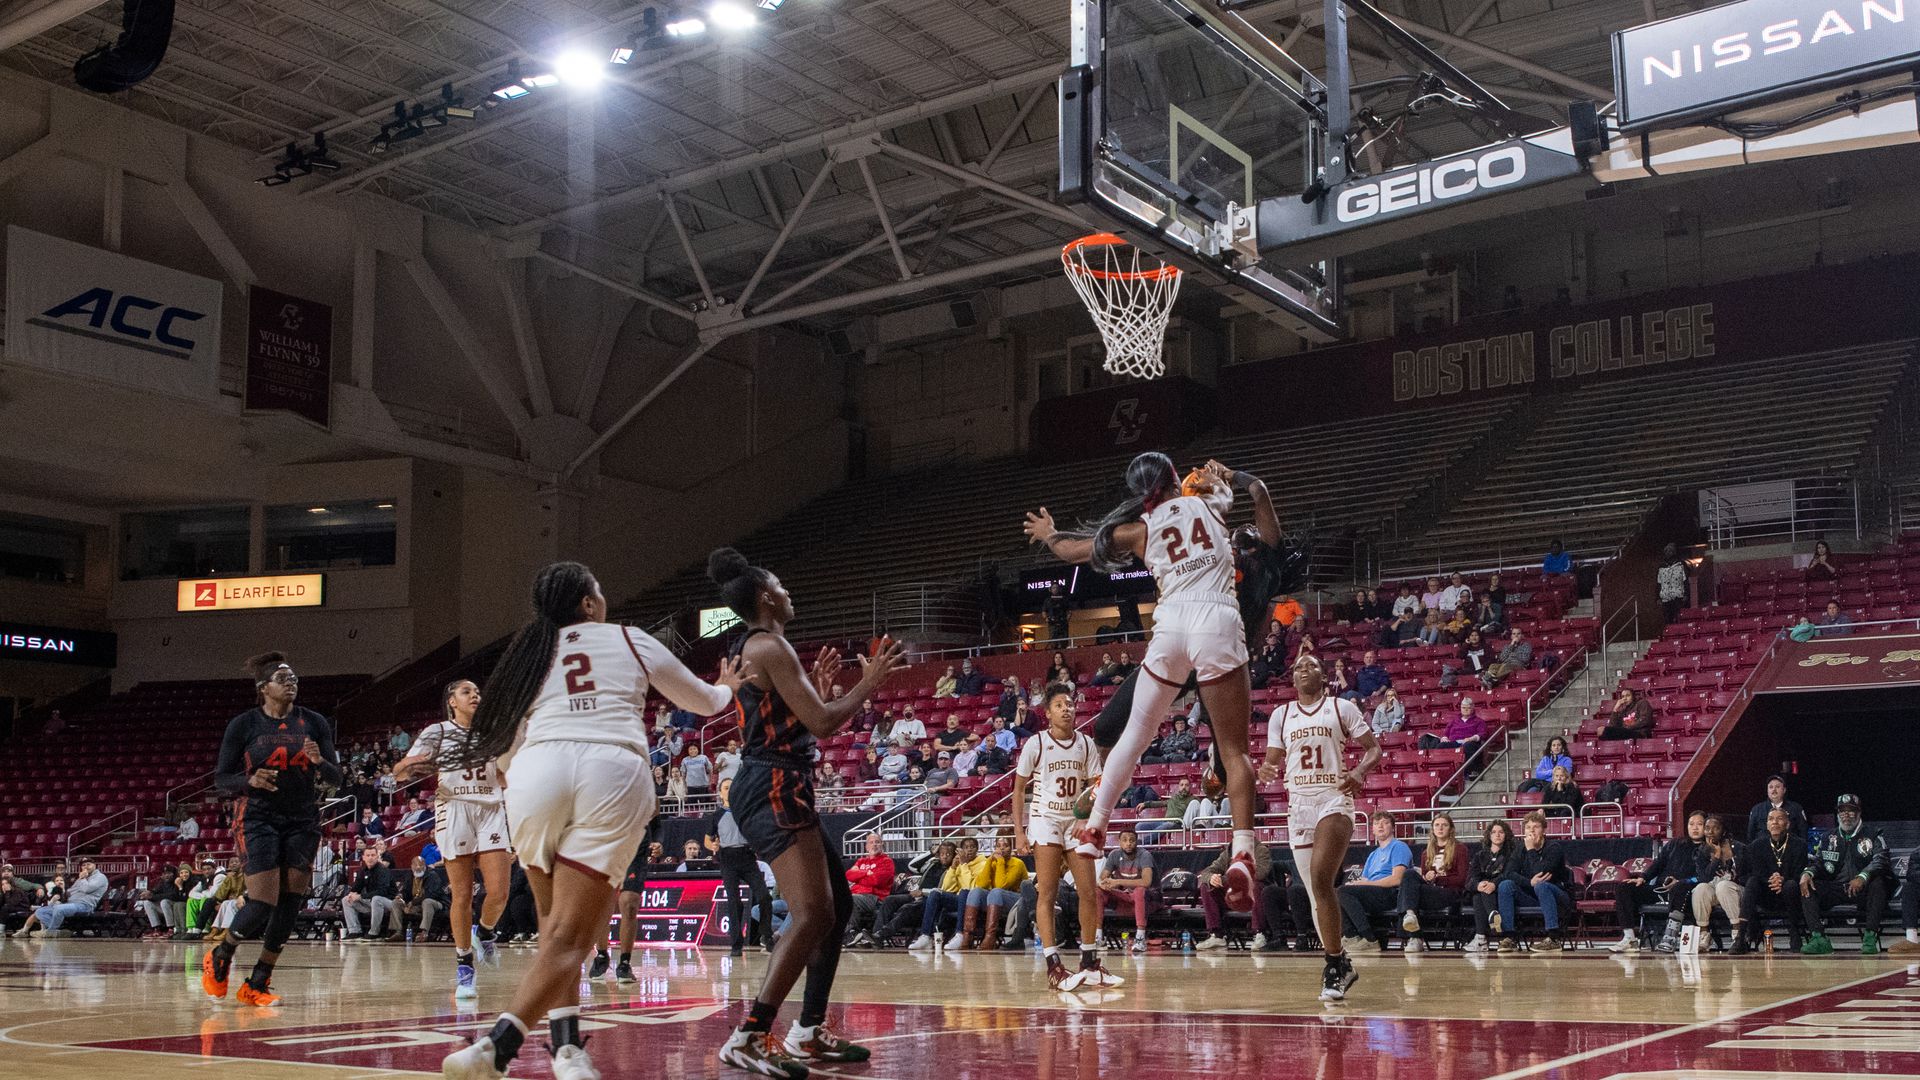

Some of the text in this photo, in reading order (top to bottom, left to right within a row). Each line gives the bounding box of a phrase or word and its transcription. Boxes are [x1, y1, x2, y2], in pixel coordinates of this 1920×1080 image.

[1642, 0, 1905, 85] NISSAN
[1336, 145, 1527, 223] GEICO
[41, 287, 206, 350] ACC
[259, 329, 312, 353] WILLIAM
[259, 343, 301, 363] FLYNN
[1393, 302, 1716, 402] BOSTON COLLEGE
[1161, 517, 1214, 564] 24
[1110, 571, 1125, 581] that
[1125, 569, 1149, 579] makes
[1175, 554, 1217, 577] WAGGONER
[224, 585, 305, 600] LEARFIELD
[1027, 579, 1066, 590] NISSN
[0, 633, 73, 652] ISSAN
[562, 652, 596, 695] 2
[569, 697, 597, 712] IVEY
[1290, 726, 1333, 742] BOSTON
[265, 746, 310, 771] 44
[1048, 760, 1083, 773] BOSTON
[1300, 744, 1324, 770] 21
[1056, 776, 1078, 798] 30
[1294, 774, 1337, 786] COLLEGE
[453, 786, 495, 795] COLLEGE
[641, 890, 669, 908] 1:04
[645, 932, 692, 941] 4 2 2
